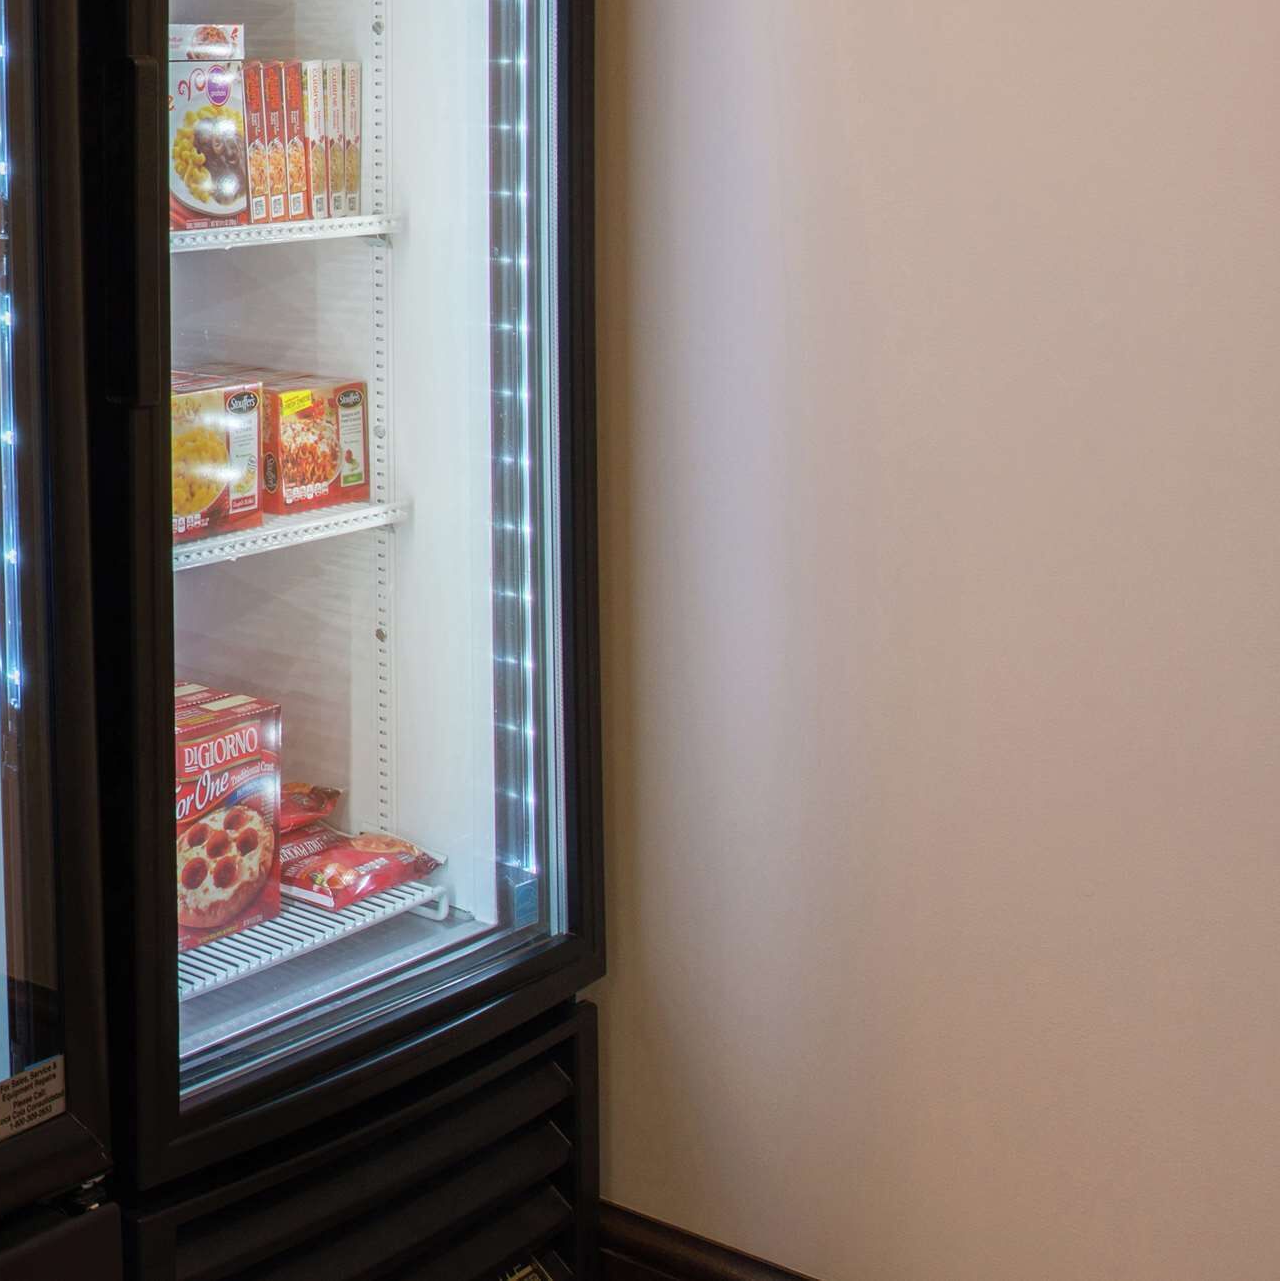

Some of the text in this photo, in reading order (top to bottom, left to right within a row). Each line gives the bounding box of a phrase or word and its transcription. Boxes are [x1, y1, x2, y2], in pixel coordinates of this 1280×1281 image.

[184, 725, 259, 773] DIGIORNO
[175, 793, 195, 820] or
[195, 770, 230, 811] One
